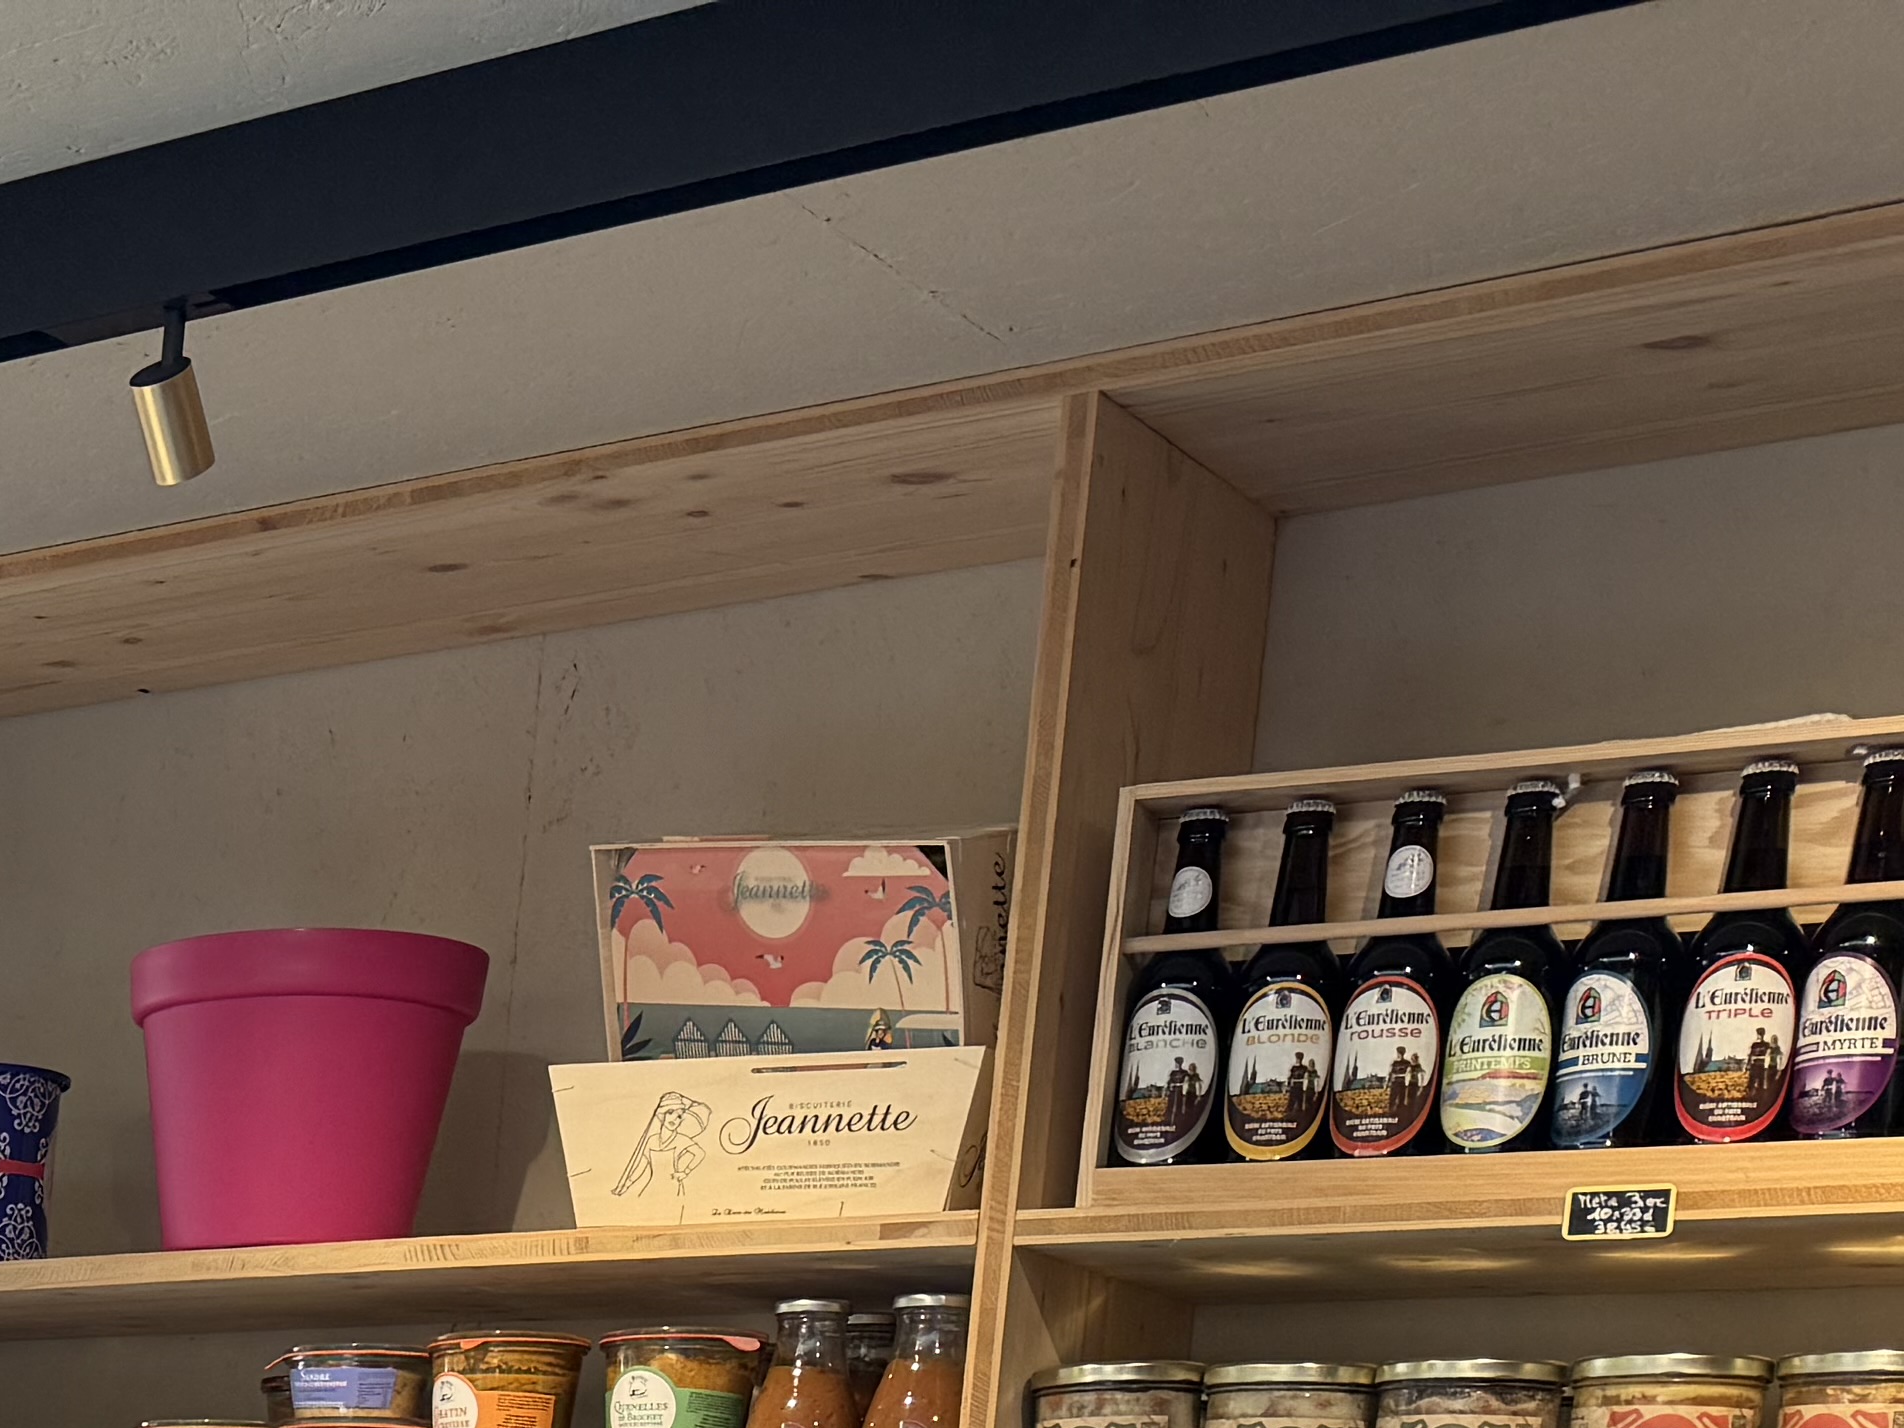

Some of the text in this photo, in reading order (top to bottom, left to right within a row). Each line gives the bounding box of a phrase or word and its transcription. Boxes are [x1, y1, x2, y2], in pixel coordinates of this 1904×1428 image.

[1695, 989, 1790, 1010] L'Eurélienne
[1344, 1010, 1431, 1030] L'Eurélienne
[1821, 1037, 1879, 1051] MYRTE
[1581, 1051, 1633, 1065] BRUNE
[789, 1101, 853, 1110] BISCUITERIE
[719, 1094, 918, 1154] Jeannette
[614, 1401, 668, 1415] QUENELLES
